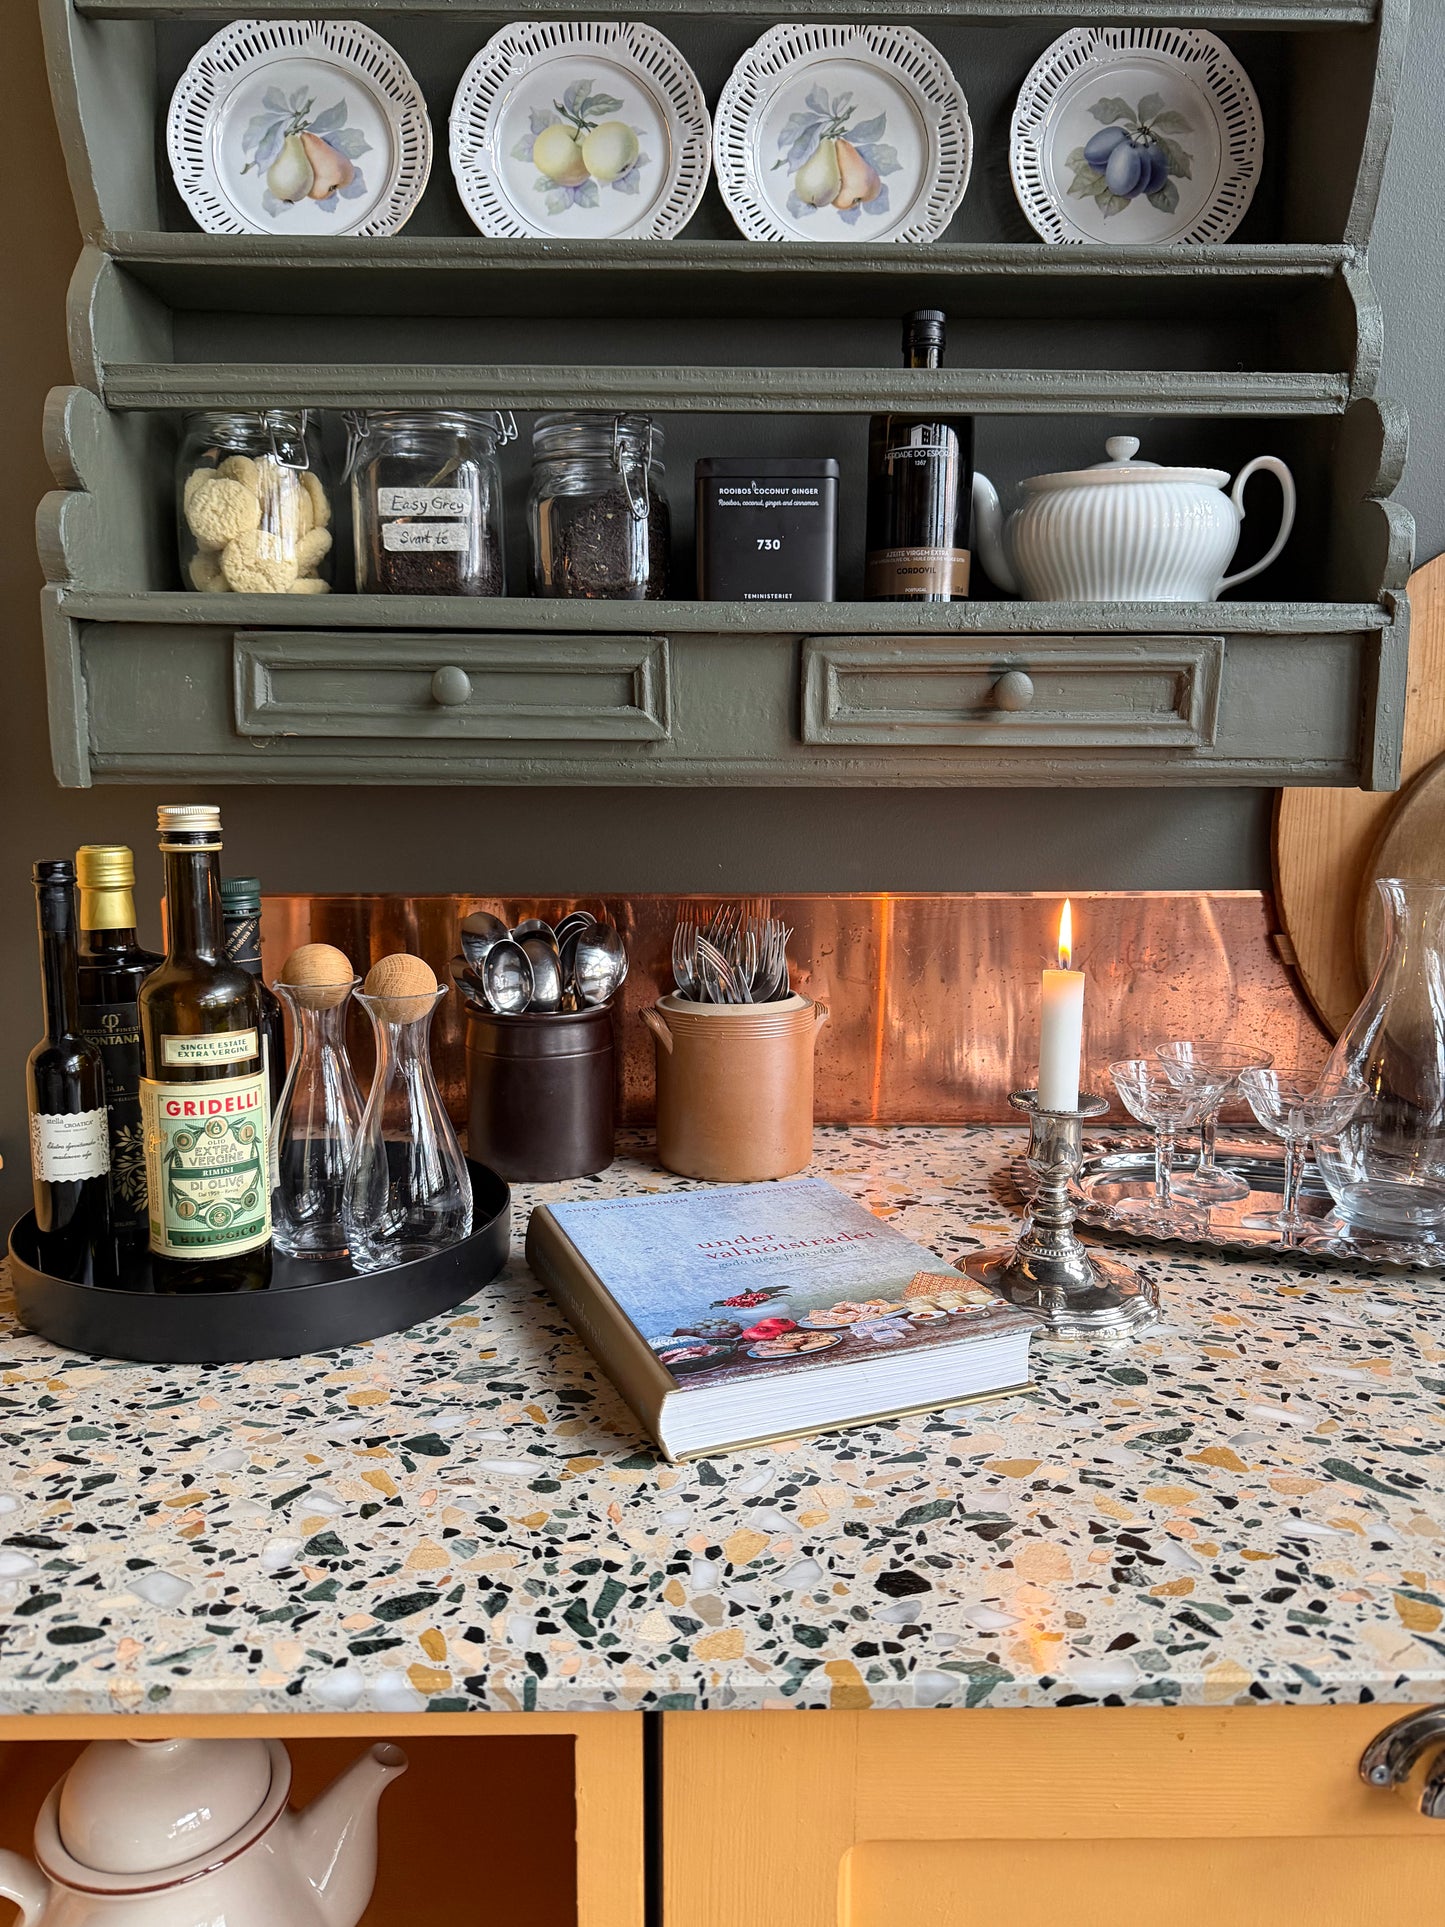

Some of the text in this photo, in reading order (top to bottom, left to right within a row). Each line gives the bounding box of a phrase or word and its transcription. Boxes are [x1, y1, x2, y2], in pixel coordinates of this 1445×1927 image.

[914, 450, 926, 458] DO
[719, 487, 818, 495] ROOIBOS COCONUT GINGER
[391, 495, 463, 515] Easy Grey
[782, 499, 794, 507] and
[400, 530, 432, 544] Svart
[757, 539, 781, 550] 730
[906, 549, 930, 557] VIRGEM
[897, 567, 936, 575] CORDOVIL
[180, 1039, 247, 1050] SINGLE ESTATE
[178, 1046, 249, 1058] EXTRA VERGINE
[166, 1091, 258, 1116] GRIDELLI
[64, 1120, 93, 1128] CROATICA
[194, 1143, 238, 1157] EXTRA
[188, 1151, 244, 1166] VERGINE
[202, 1167, 235, 1177] RIMINI
[190, 1175, 244, 1191] DI OLIVA
[180, 1225, 257, 1243] BIOLOGICO
[696, 1233, 776, 1249] under
[705, 1231, 879, 1260] valnötsträdet
[718, 1260, 748, 1269] goda
